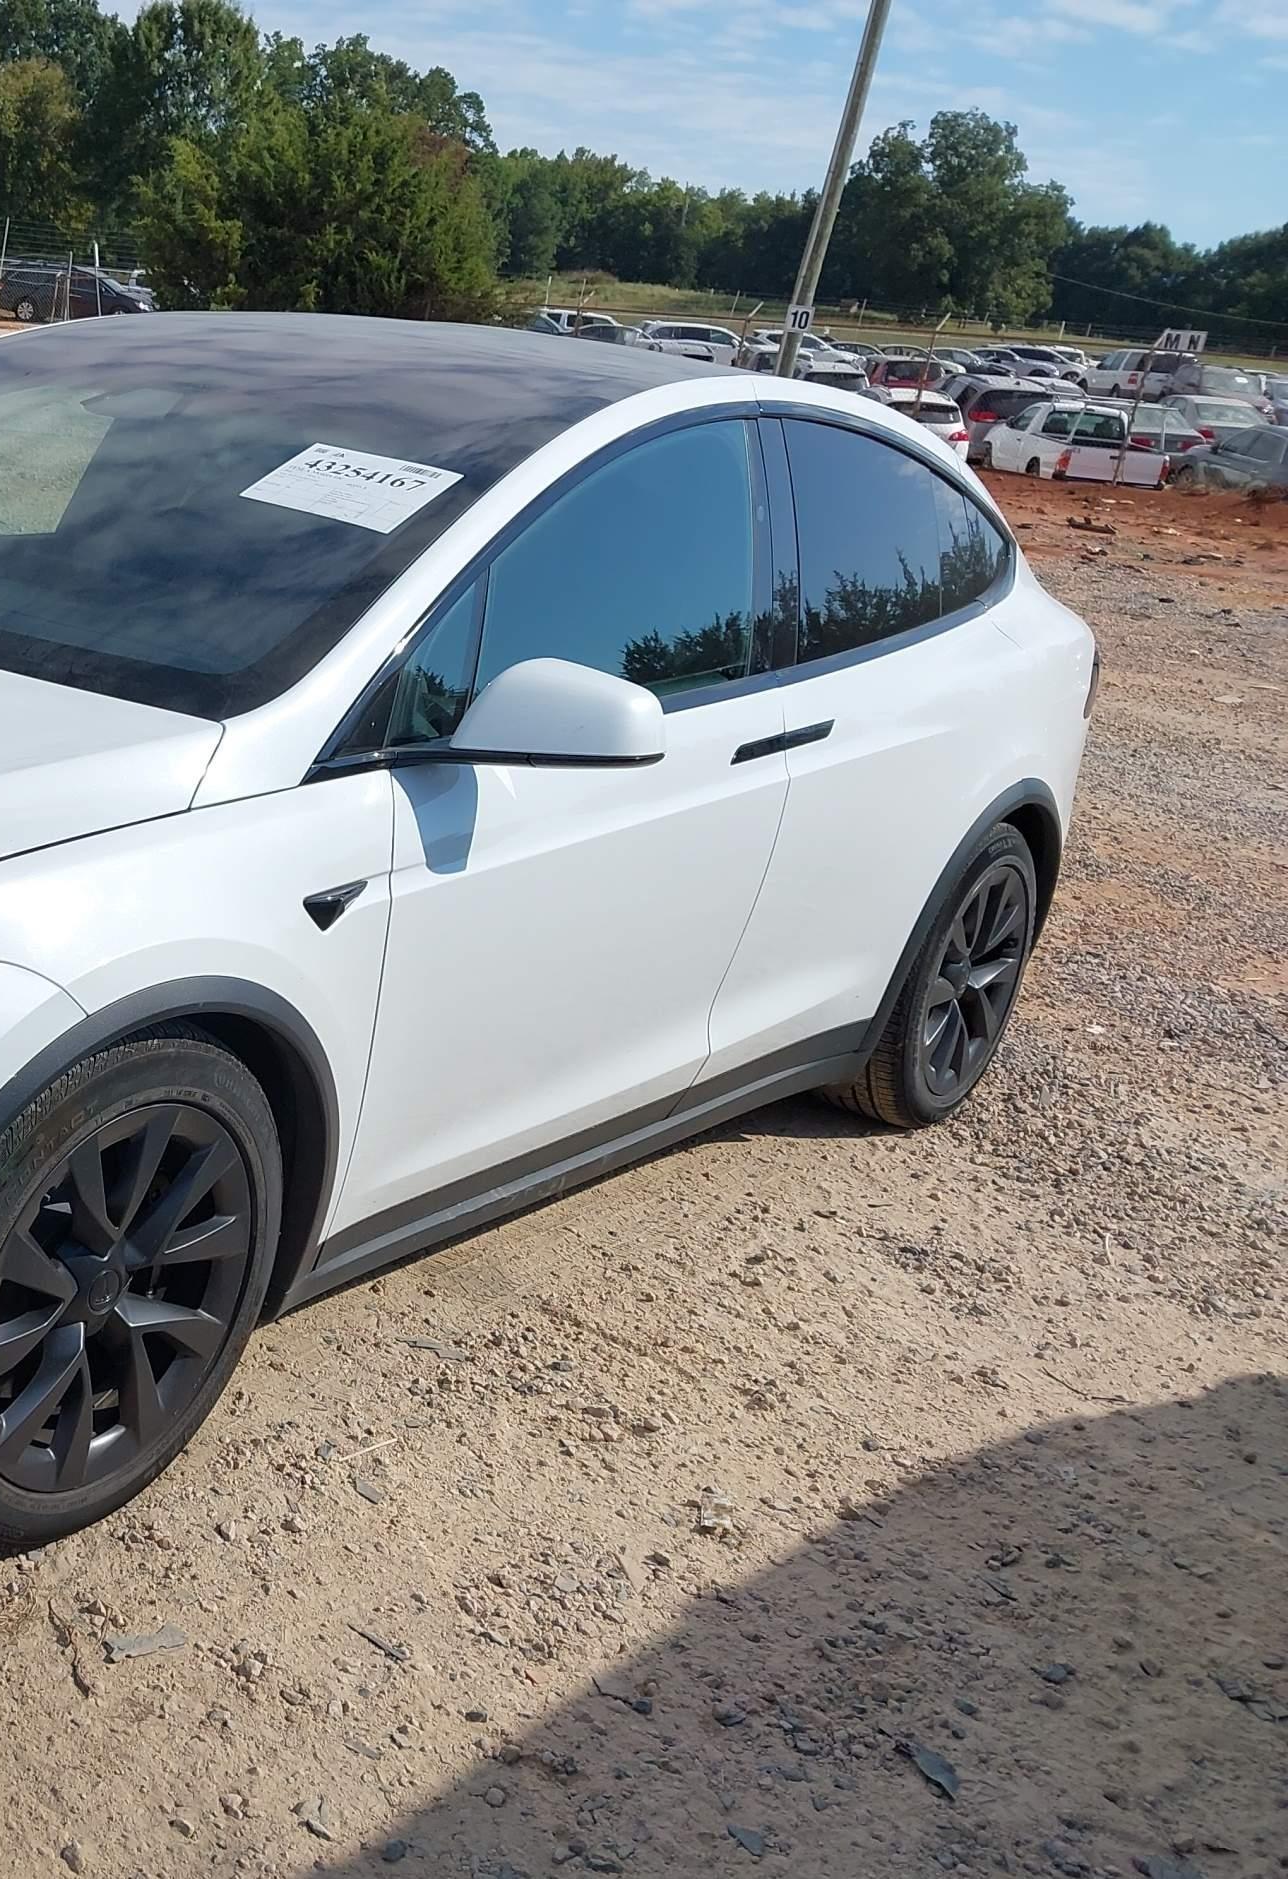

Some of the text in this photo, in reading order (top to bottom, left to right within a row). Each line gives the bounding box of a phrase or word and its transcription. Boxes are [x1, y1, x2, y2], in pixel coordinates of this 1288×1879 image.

[791, 309, 810, 330] 10
[1164, 332, 1201, 350] M N
[304, 458, 427, 493] 43254167
